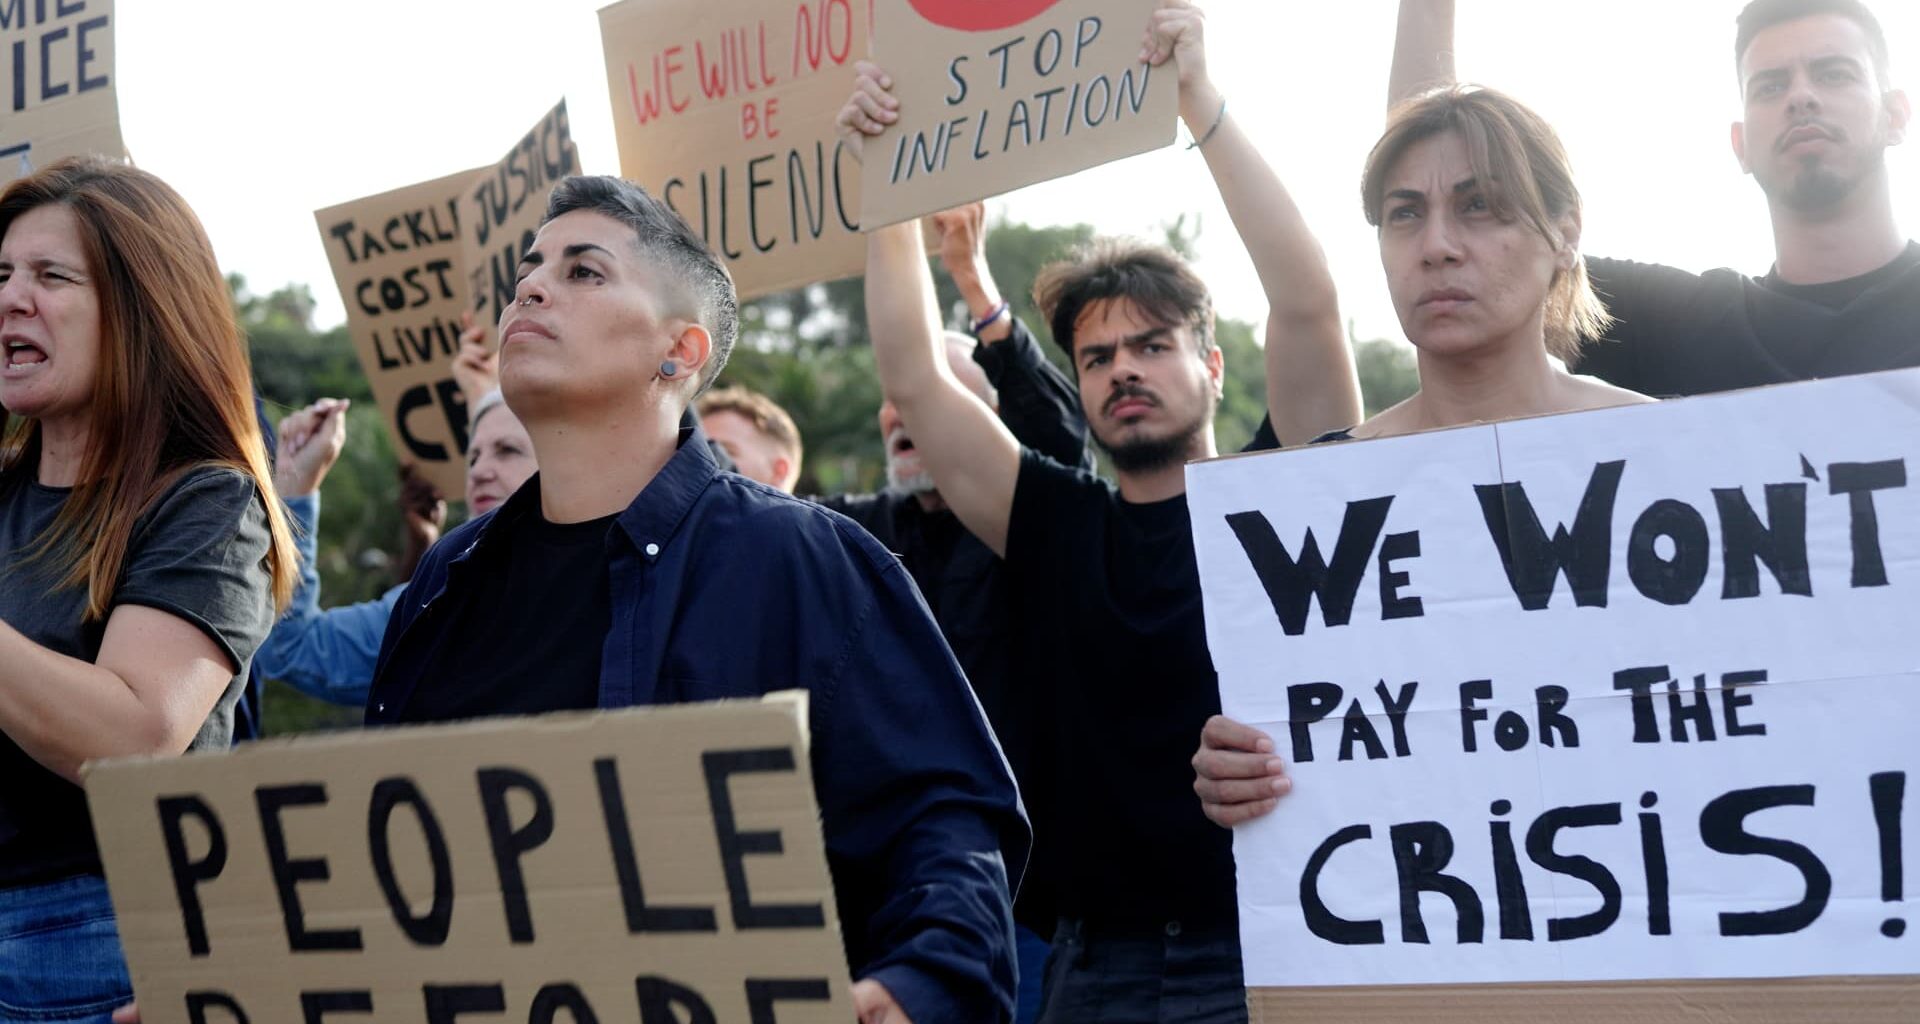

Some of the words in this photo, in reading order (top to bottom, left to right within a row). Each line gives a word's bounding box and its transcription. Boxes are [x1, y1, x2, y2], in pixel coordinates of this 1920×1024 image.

[628, 45, 690, 126] WE
[695, 20, 776, 99] WILL
[792, 0, 874, 77] NO
[945, 15, 1102, 106] STOP
[742, 98, 780, 140] BE
[890, 62, 1150, 184] INFLATION
[355, 259, 454, 315] COST
[1224, 495, 1425, 637] WE
[1472, 451, 1908, 612] WON'T
[1287, 677, 1418, 763] PAY
[1459, 678, 1580, 753] FOR
[1612, 664, 1768, 744] THE
[155, 747, 826, 957] PEOPLE
